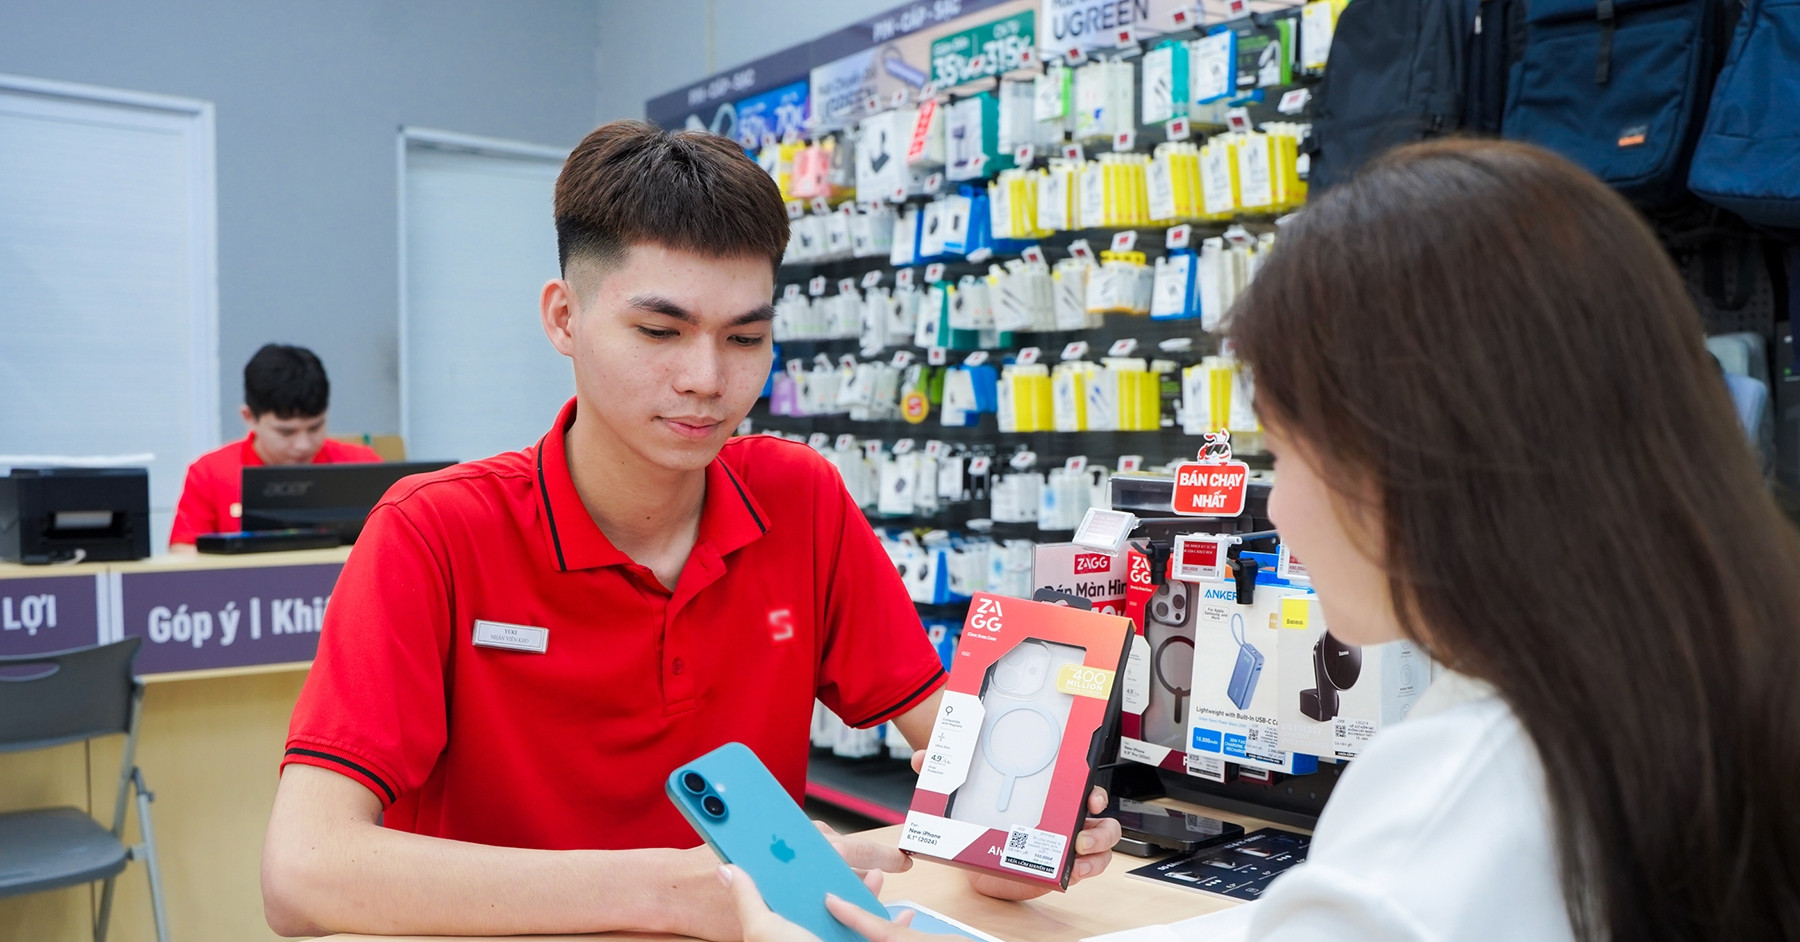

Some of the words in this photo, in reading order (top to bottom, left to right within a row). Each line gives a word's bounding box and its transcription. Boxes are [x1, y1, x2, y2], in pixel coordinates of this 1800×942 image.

[1052, 0, 1148, 40] UGREEN
[1180, 470, 1208, 487] BÁN
[1209, 473, 1244, 490] CHẠY
[1192, 490, 1227, 508] NHẤT
[1077, 556, 1108, 571] ZAGG
[1076, 582, 1103, 598] Màn
[2, 594, 57, 636] LỢI
[147, 604, 213, 648] Góp
[218, 601, 241, 647] ý
[768, 609, 794, 641] S
[1065, 679, 1103, 692] MILLION
[1072, 668, 1106, 685] 400
[1195, 706, 1225, 717] Lightweight
[1225, 711, 1236, 719] with
[1236, 712, 1255, 721] Built-In
[1255, 716, 1272, 725] USB-C
[909, 827, 922, 835] New
[922, 829, 941, 839] iPhone
[918, 836, 937, 846] (2024)
